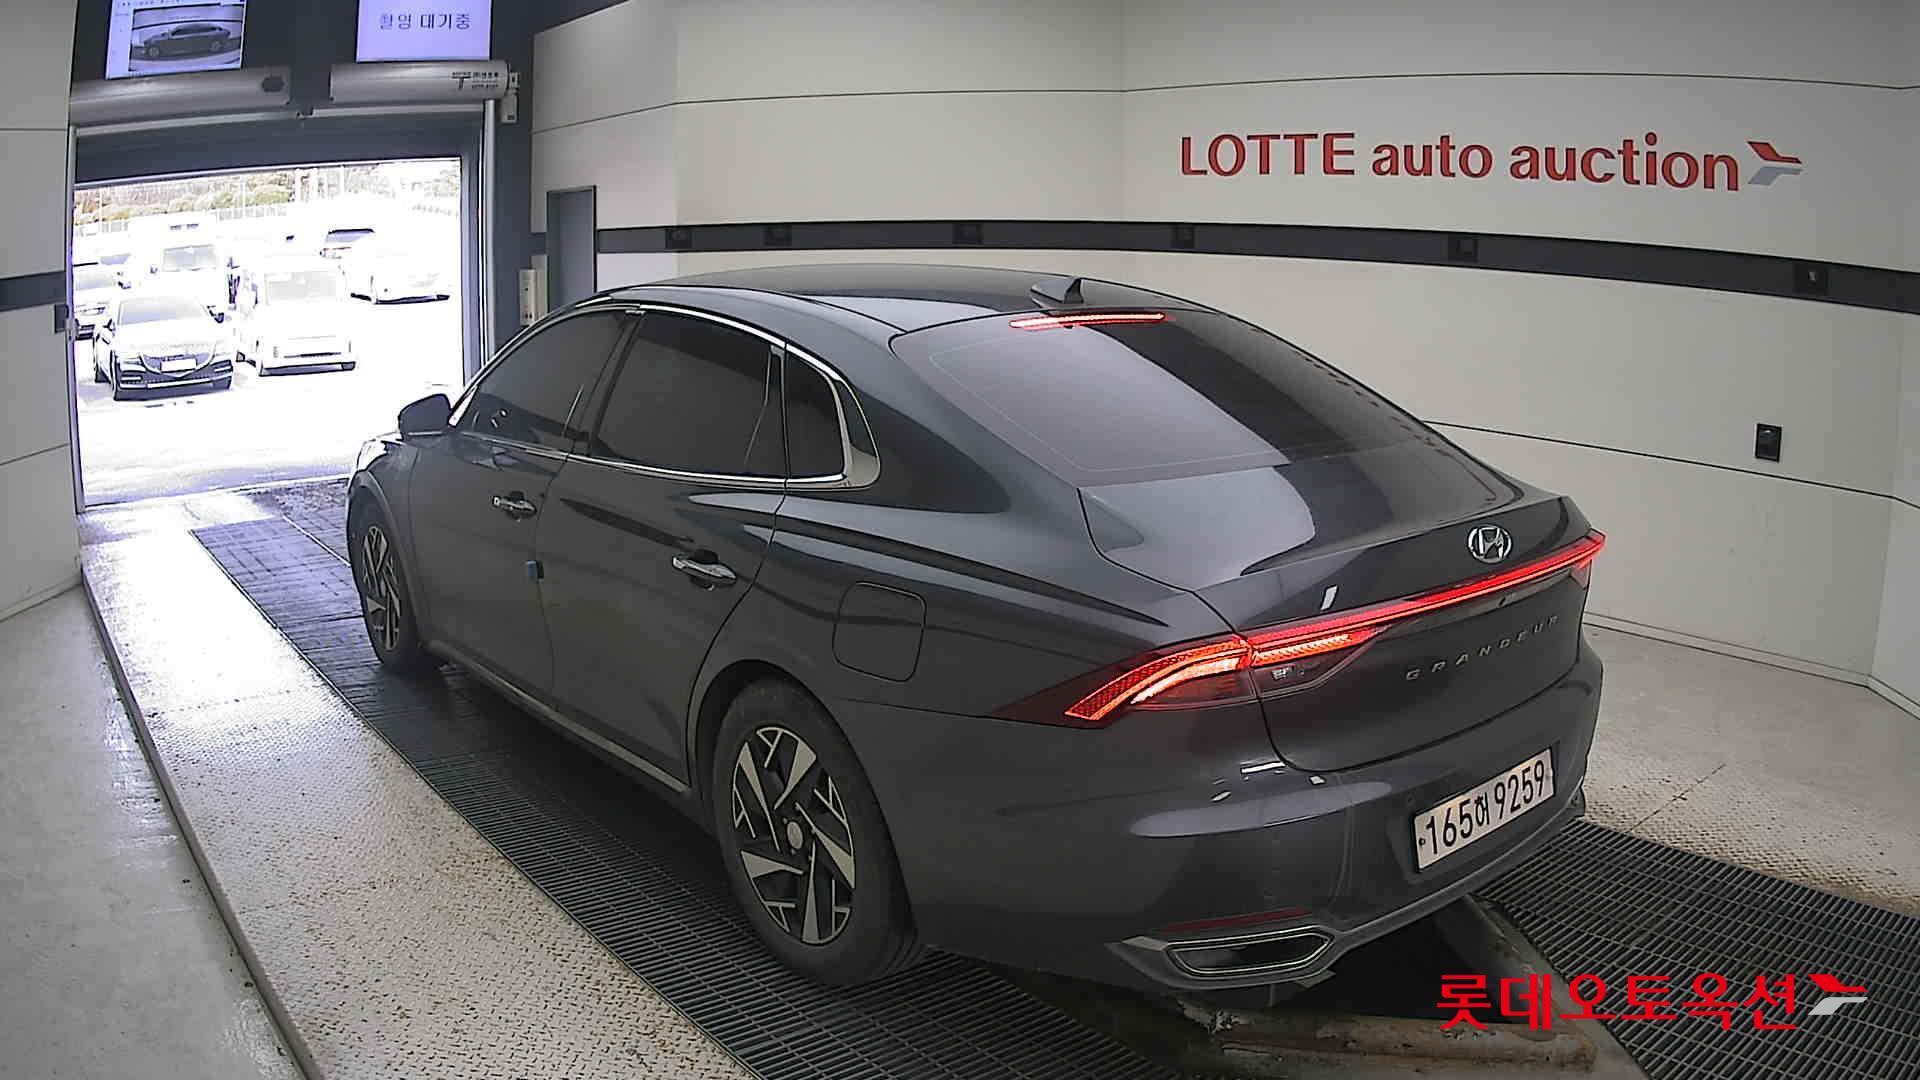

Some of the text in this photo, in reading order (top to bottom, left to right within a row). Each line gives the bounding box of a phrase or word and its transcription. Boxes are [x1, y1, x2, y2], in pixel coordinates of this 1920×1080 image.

[420, 13, 472, 30] 대기중
[1181, 132, 1739, 191] LOTTE auto auction
[1405, 615, 1561, 680] GRANDEUR
